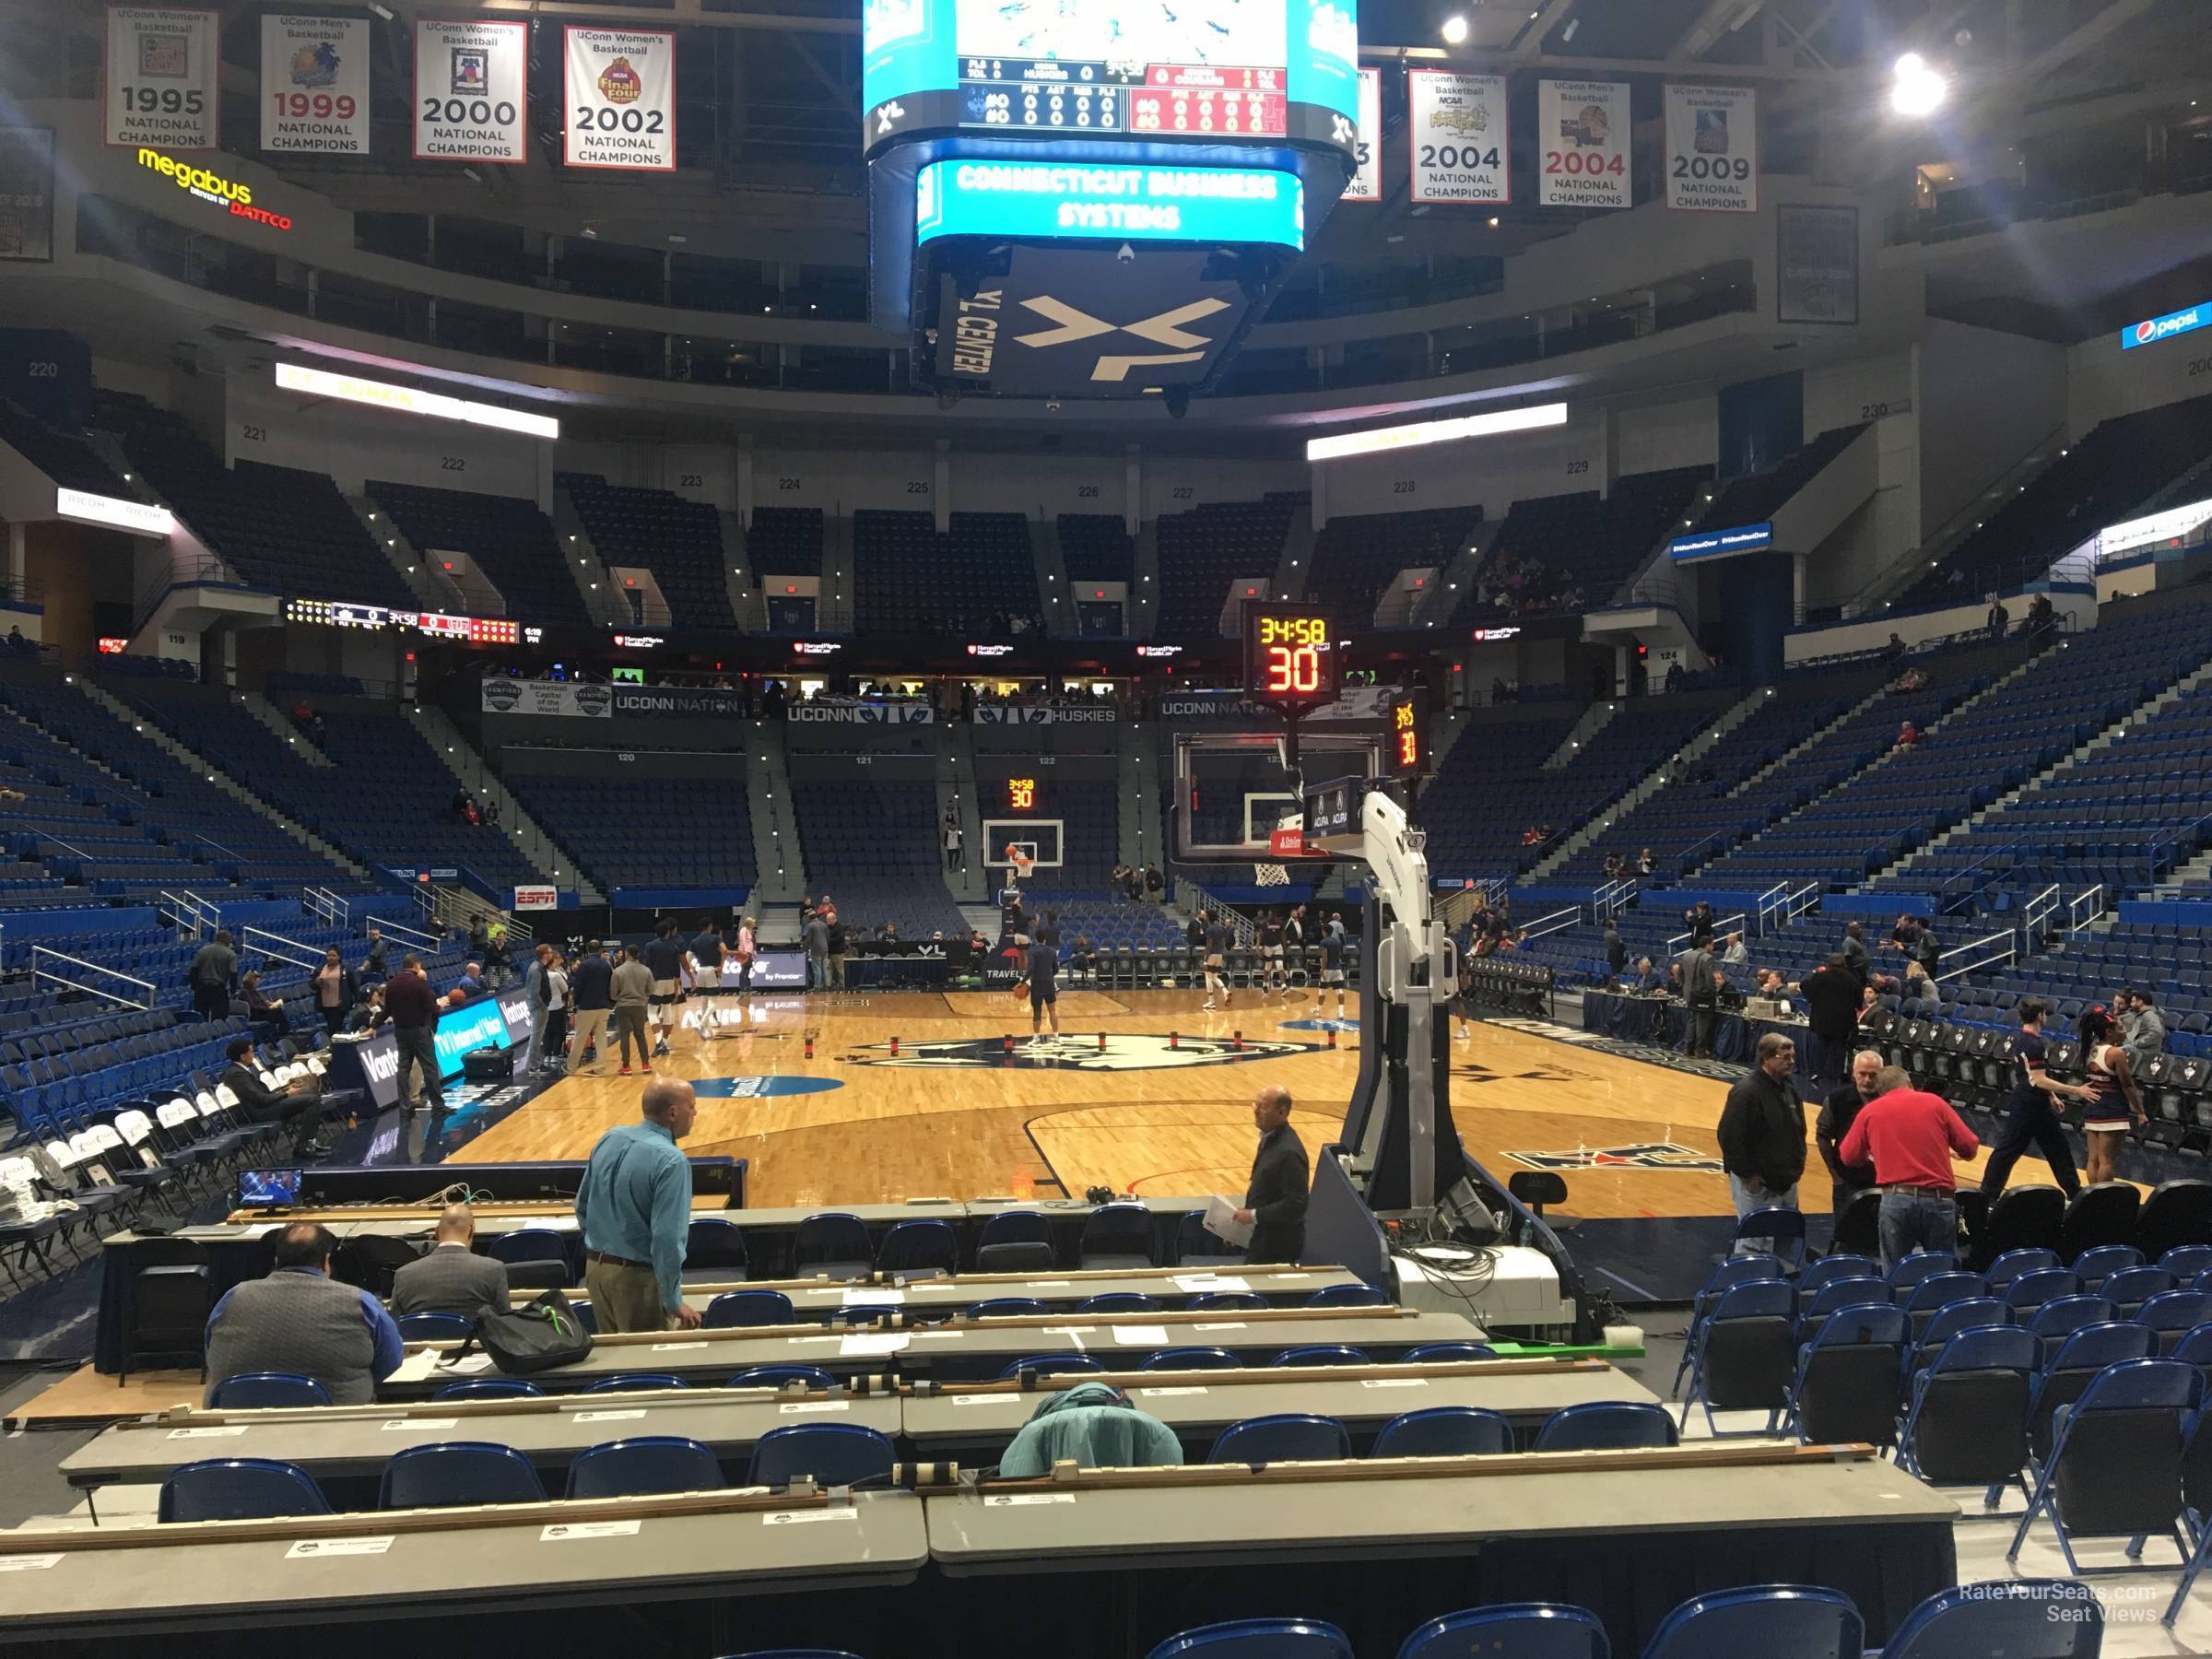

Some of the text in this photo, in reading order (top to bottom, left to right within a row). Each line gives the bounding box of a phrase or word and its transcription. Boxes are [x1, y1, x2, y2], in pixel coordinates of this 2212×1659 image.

[135, 22, 192, 33] Basketball
[288, 29, 344, 40] Basketball
[442, 36, 498, 46] Basketball
[593, 44, 647, 55] Basketball
[1080, 65, 1093, 80] 0
[1435, 86, 1484, 96] Basketball
[122, 87, 203, 114] 1995
[1560, 93, 1609, 103] Basketball
[274, 93, 355, 119] 1999
[423, 99, 516, 125] 2000
[125, 116, 200, 130] NATIONAL
[576, 106, 664, 134] 2002
[278, 123, 351, 135] NATIONAL
[433, 129, 505, 141] NATIONAL
[119, 132, 206, 146] CHAMPIONS
[272, 137, 358, 150] CHAMPIONS
[585, 136, 656, 149] NATIONAL
[428, 143, 512, 157] CHAMPIONS
[579, 150, 662, 164] CHAMPIONS
[1419, 145, 1500, 170] 2004
[1546, 151, 1626, 176] 2004
[1673, 156, 1749, 181] 2009
[138, 148, 252, 204] megabus
[957, 164, 1277, 200] CONNECTICUT BUSINESS
[1430, 173, 1492, 184] NATIONAL
[1555, 180, 1618, 191] NATIONAL
[1681, 183, 1742, 195] NATIONAL
[190, 186, 229, 206] DRIVEN BY
[1424, 187, 1499, 198] CHAMPIONS
[1549, 193, 1622, 205] CHAMPIONS
[1676, 196, 1747, 209] CHAMPIONS
[229, 201, 292, 229] DATTCO
[1057, 203, 1181, 229] SYSTEMS
[2158, 310, 2198, 336] pepsi
[954, 318, 998, 373] CENTER
[29, 362, 57, 377] 220
[1861, 404, 1888, 418] 230
[243, 426, 266, 442] 221
[441, 456, 465, 471] 222
[1567, 461, 1589, 475] 229
[680, 475, 702, 488] 223
[779, 477, 800, 490] 224
[907, 481, 929, 494] 225
[1394, 480, 1416, 494] 228
[1173, 487, 1194, 500] 227
[68, 494, 161, 520] RICOH RICOH
[369, 610, 378, 620] 0
[389, 613, 418, 626] 34:58
[429, 618, 438, 628] 0
[1261, 618, 1325, 643] 34:58
[1660, 651, 1677, 661] 124
[1269, 647, 1318, 691] 30
[529, 683, 567, 691] Basketball
[535, 692, 561, 700] Capital
[617, 696, 674, 710] UCONN
[1162, 702, 1215, 714] UCONN
[788, 708, 853, 722] UCONN
[1052, 710, 1115, 722] HUSKIES
[618, 753, 635, 761] 120
[856, 757, 871, 765] 121
[1040, 757, 1055, 765] 122
[1009, 780, 1034, 790] 34:58
[1012, 790, 1032, 808] 30
[1314, 813, 1347, 828] ACURA ACURA
[516, 892, 555, 903] ESPN
[987, 970, 1025, 978] TRAVEL
